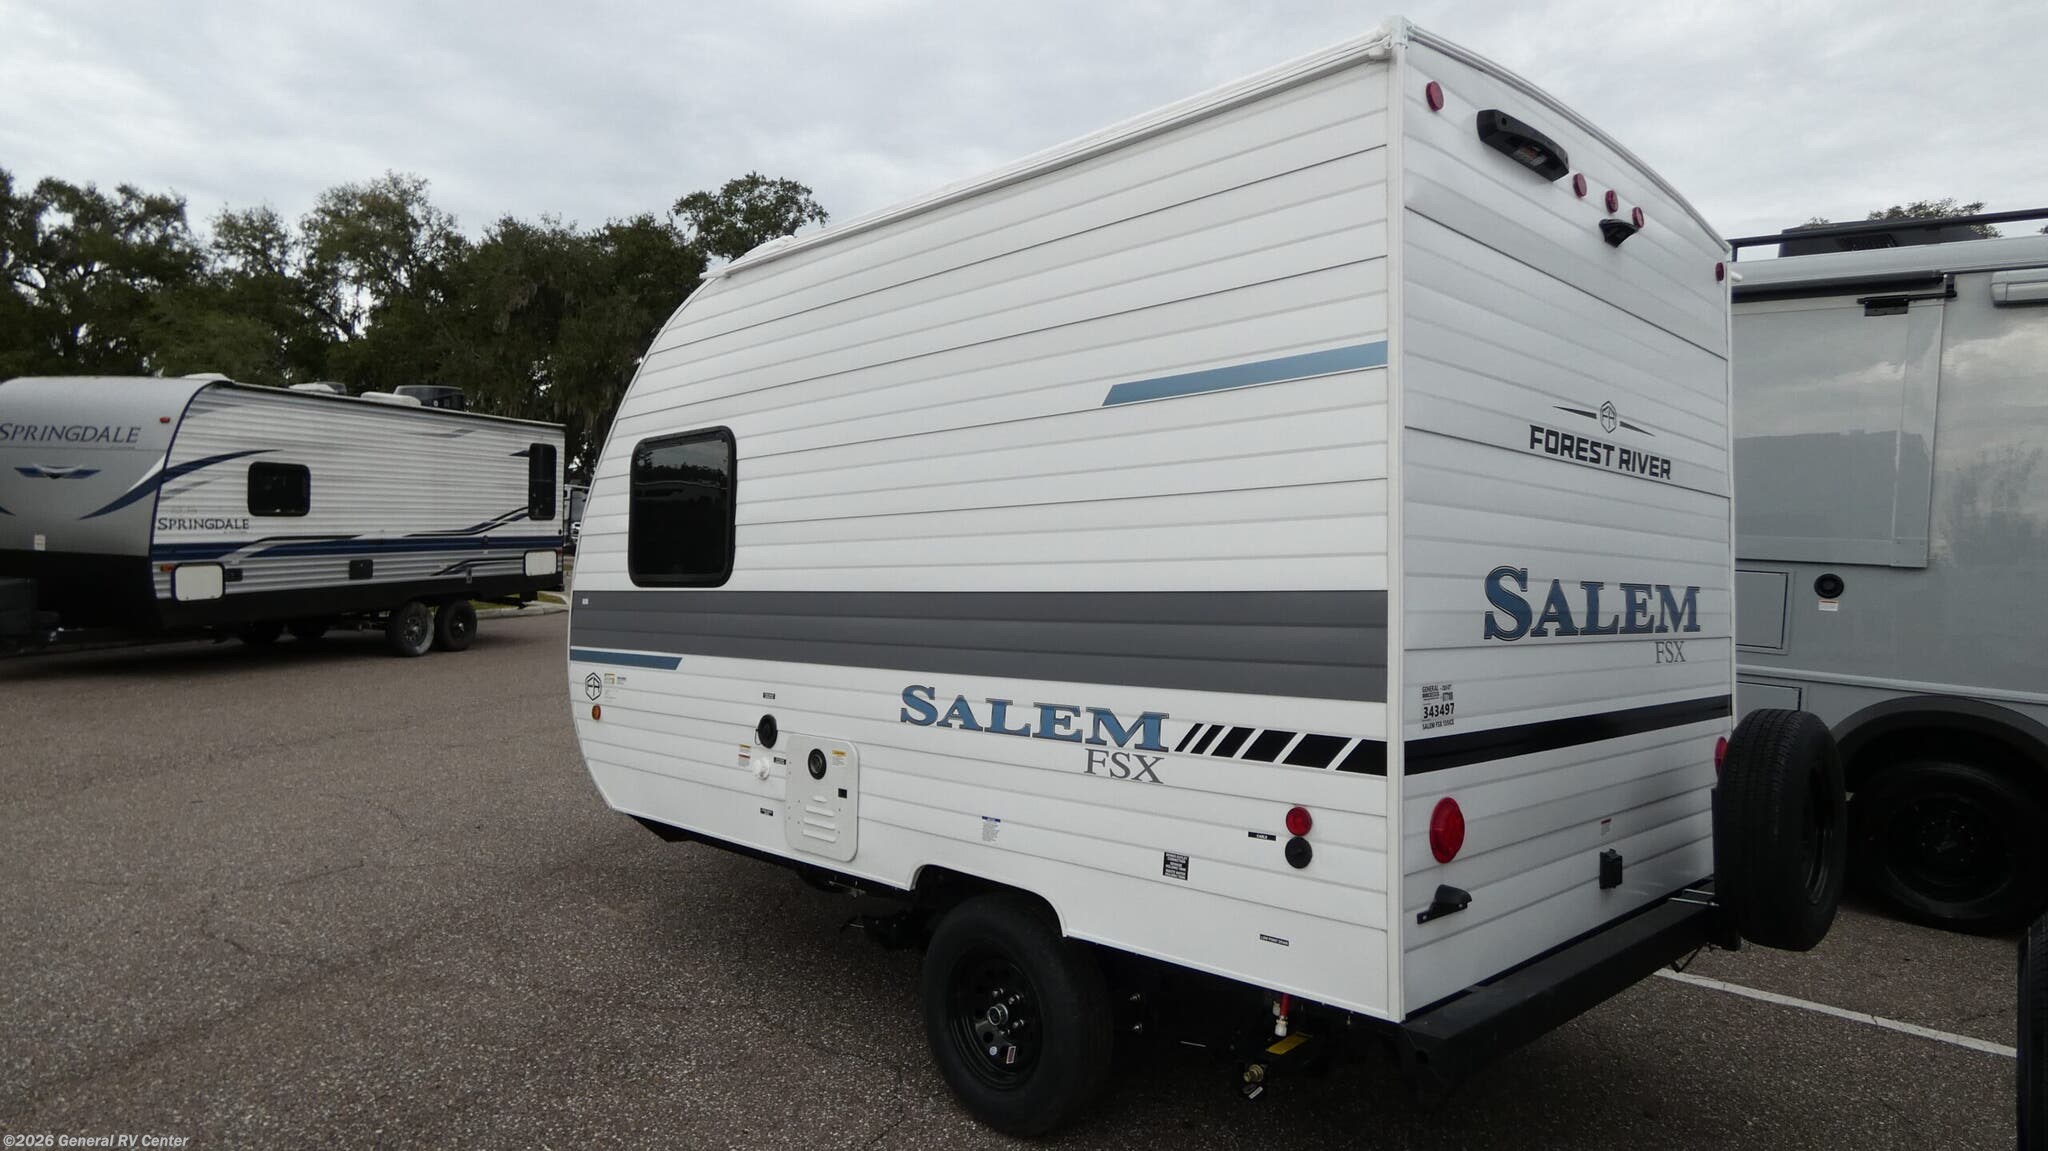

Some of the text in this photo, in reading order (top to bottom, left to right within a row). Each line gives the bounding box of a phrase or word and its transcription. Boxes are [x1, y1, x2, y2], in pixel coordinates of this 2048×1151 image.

[0, 422, 141, 443] SPRINGDALE
[1529, 424, 1671, 480] FOREST RIVER
[157, 517, 249, 531] SPRINGDALE
[1484, 565, 1701, 642] SALEM
[1654, 640, 1687, 664] FSX
[900, 684, 1169, 752] SALEM
[1423, 703, 1455, 719] 343497
[1084, 748, 1164, 784] FSX
